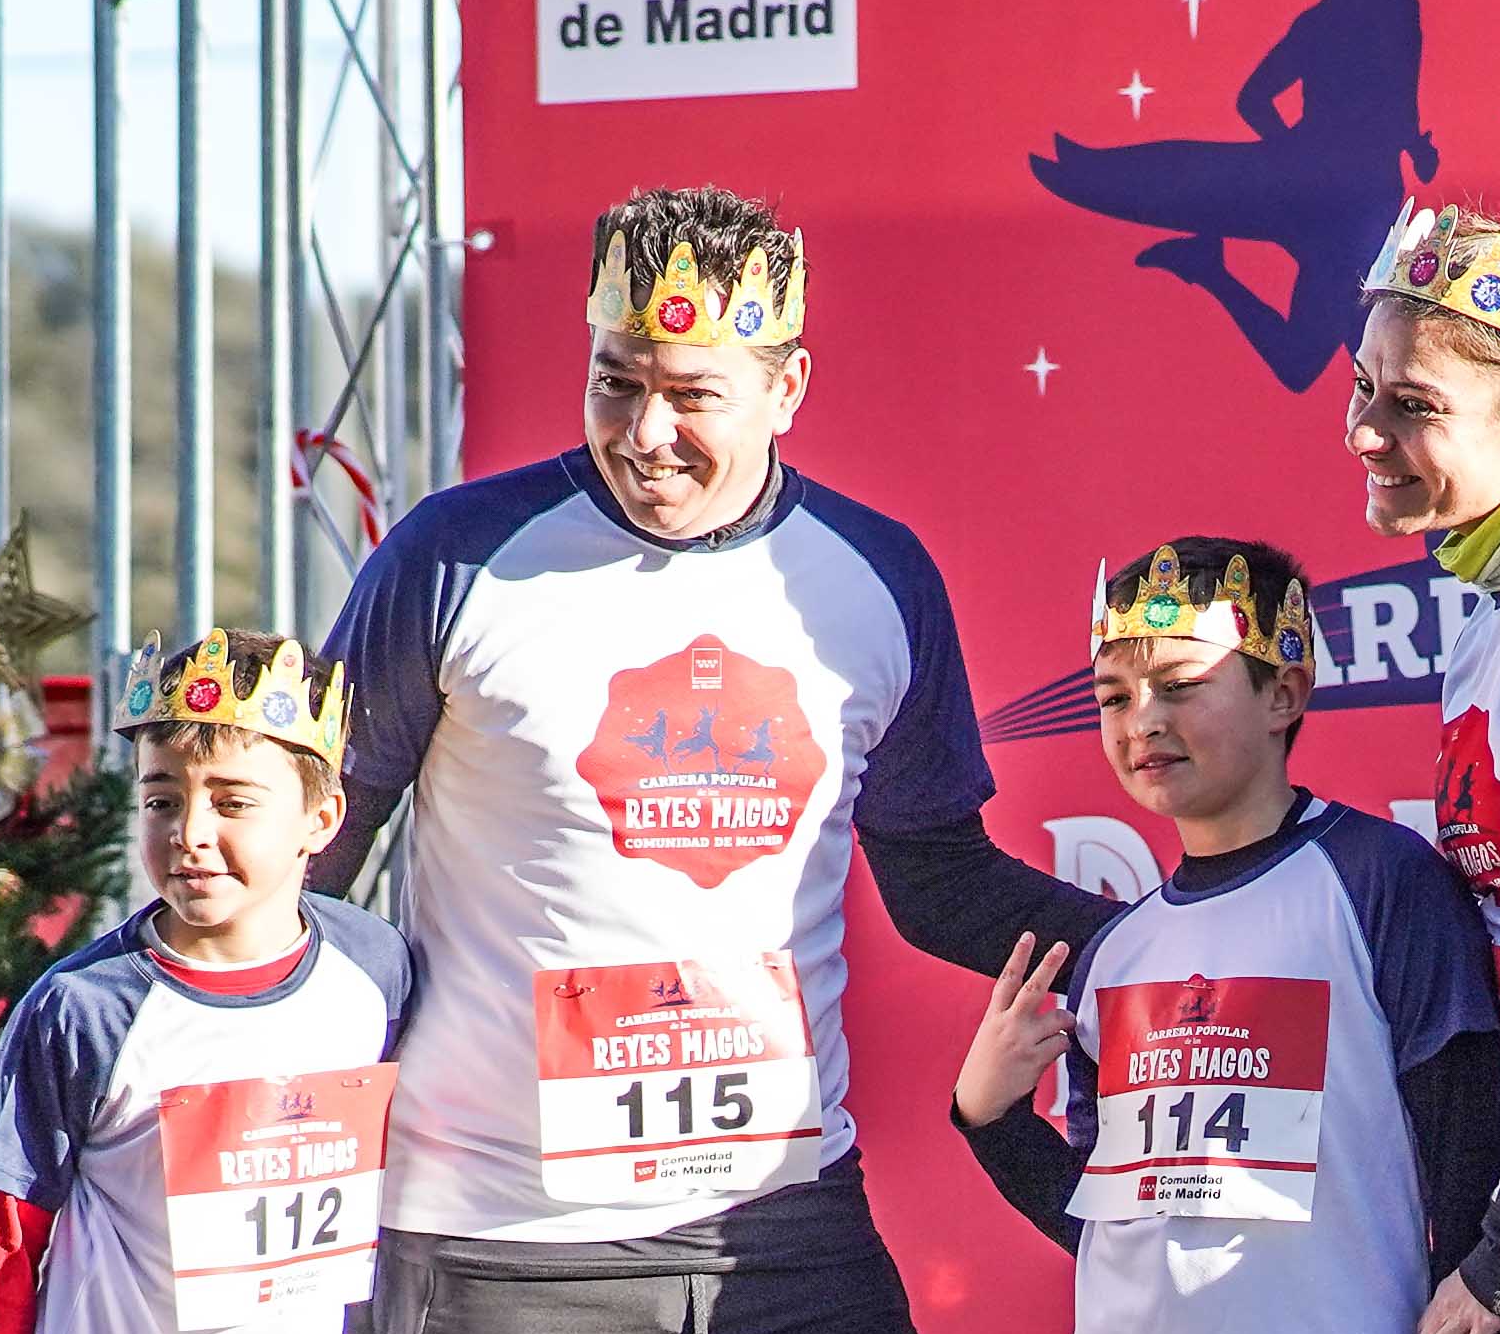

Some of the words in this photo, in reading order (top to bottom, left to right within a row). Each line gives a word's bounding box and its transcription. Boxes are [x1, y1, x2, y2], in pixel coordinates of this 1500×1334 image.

[559, 3, 624, 49] de
[639, 773, 707, 790] CARRERA
[711, 773, 777, 789] POPULAR
[624, 796, 701, 830] REYES
[711, 796, 792, 830] MAGOS
[624, 836, 710, 850] COMUNIDAD
[714, 836, 732, 849] DE
[735, 834, 783, 847] MADRID
[592, 1033, 671, 1071] REYES
[681, 1025, 765, 1064] MAGOS
[1146, 1026, 1193, 1042] CARRERA
[1195, 1025, 1250, 1039] POPULAR
[1128, 1048, 1182, 1085] REYES
[1189, 1047, 1270, 1081] MAGOS
[616, 1072, 754, 1138] 115
[1138, 1092, 1250, 1155] 114
[218, 1147, 291, 1185] REYES
[660, 1168, 677, 1178] de
[683, 1163, 732, 1176] Madrid
[661, 1151, 733, 1166] Comunidad
[1158, 1187, 1172, 1200] de
[1175, 1187, 1221, 1200] Madrid
[1160, 1174, 1223, 1186] Comunidad
[245, 1186, 342, 1256] 112
